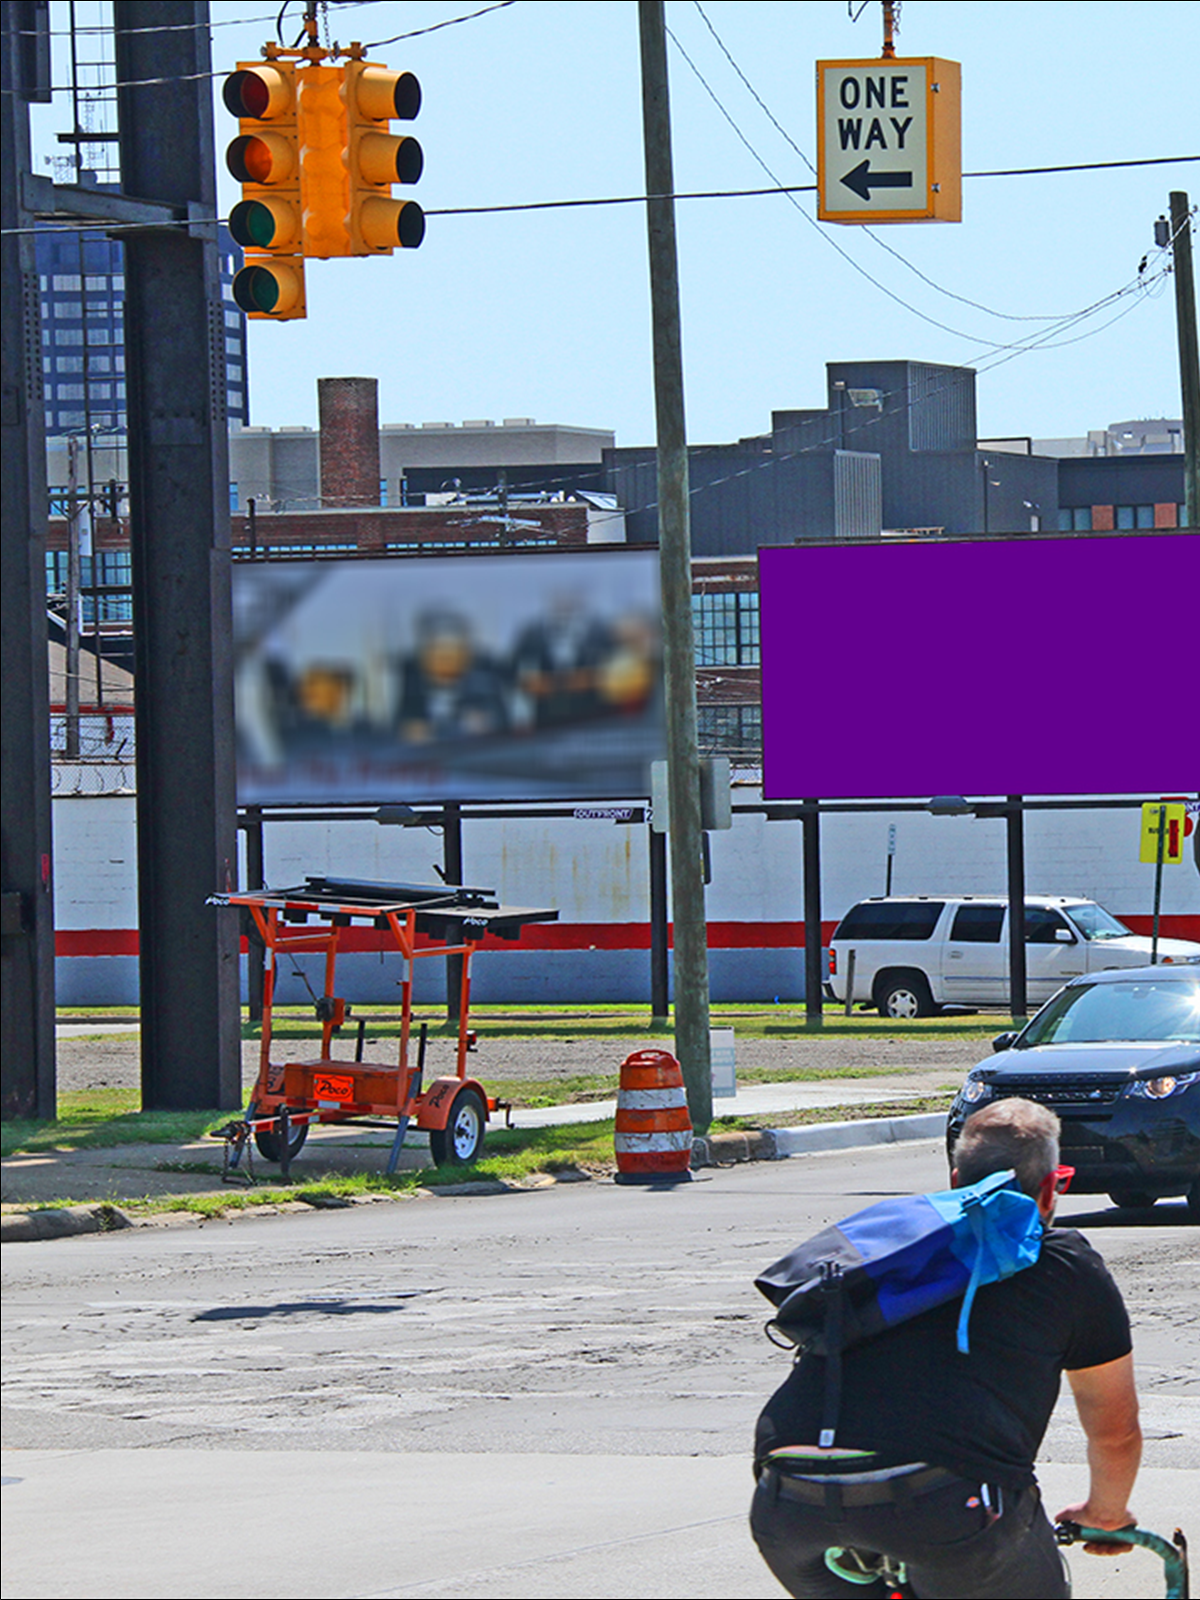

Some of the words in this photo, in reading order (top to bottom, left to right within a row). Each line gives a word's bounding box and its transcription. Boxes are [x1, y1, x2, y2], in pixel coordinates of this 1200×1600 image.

[840, 76, 909, 110] ONE
[838, 117, 913, 150] WAY
[320, 1080, 349, 1096] Poco
